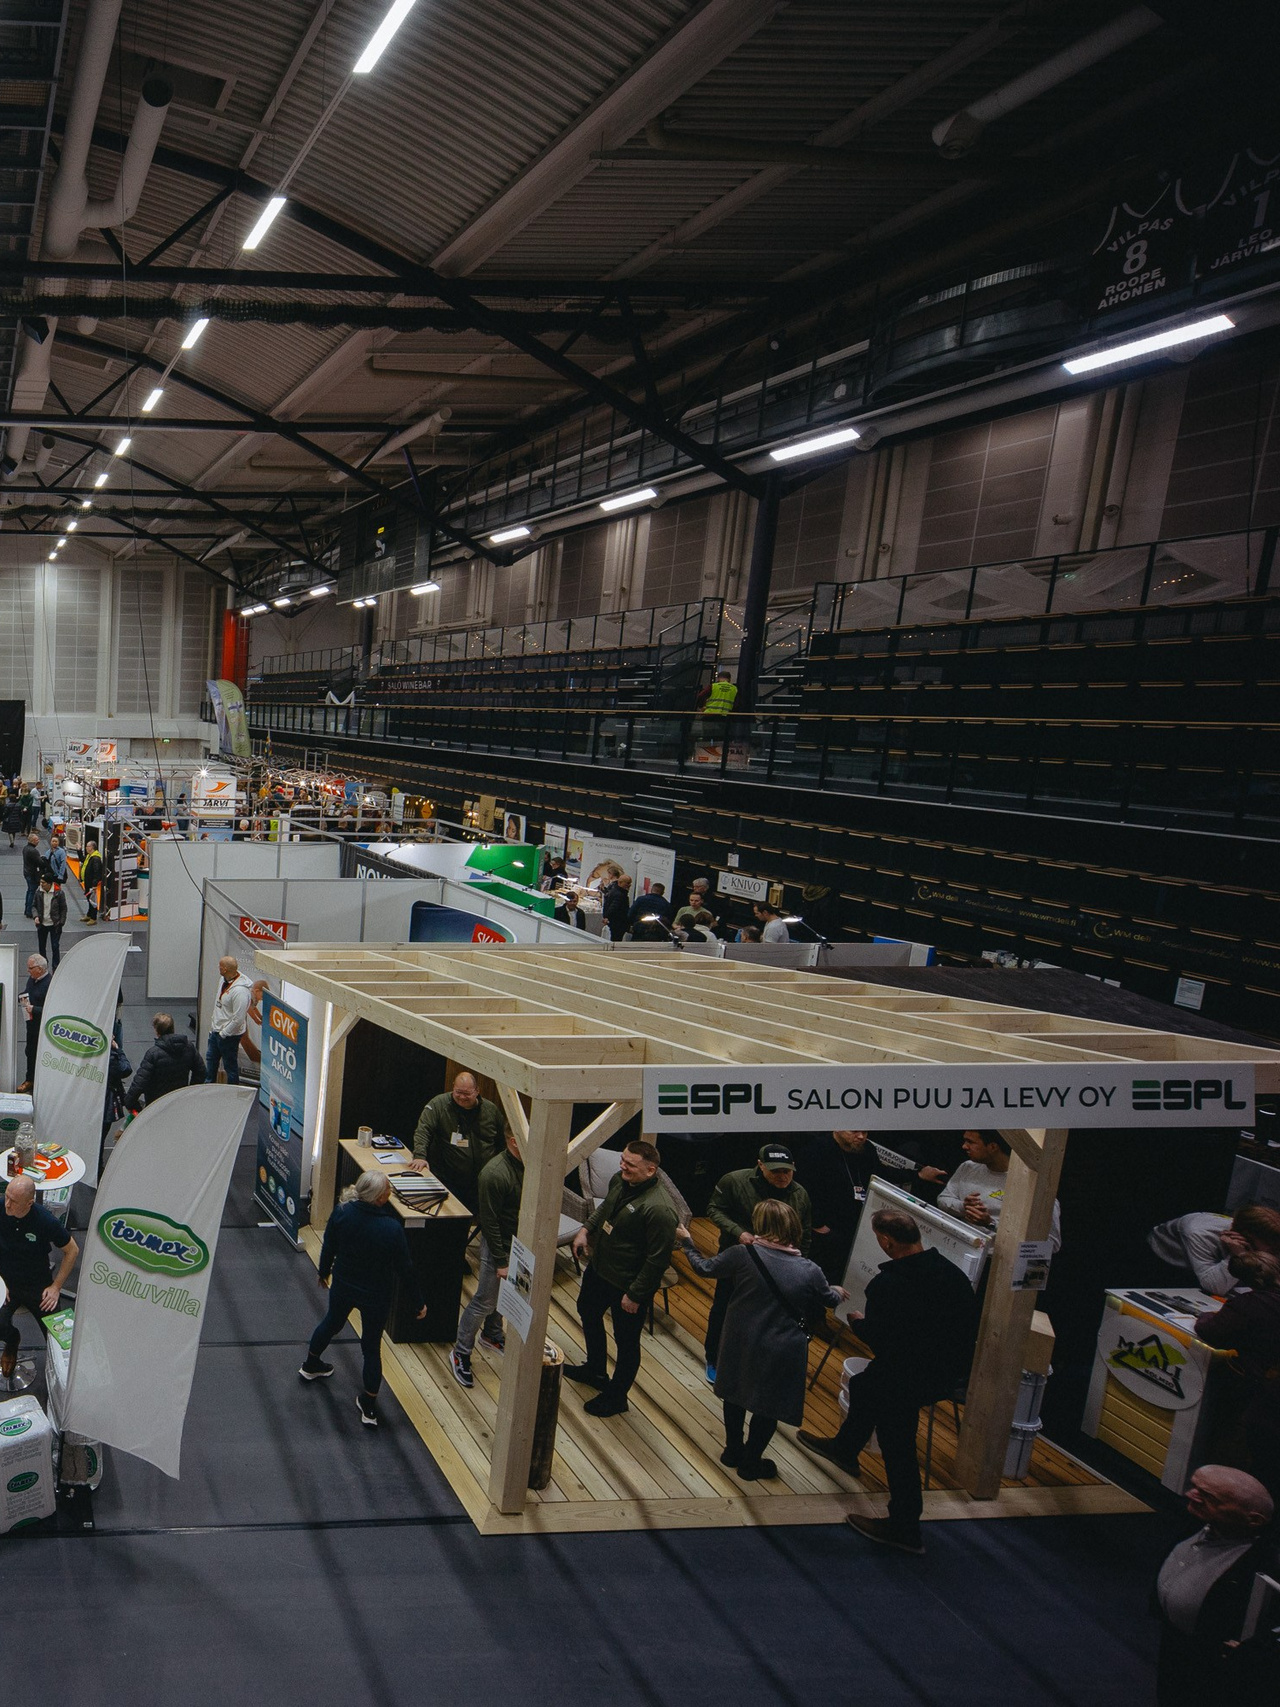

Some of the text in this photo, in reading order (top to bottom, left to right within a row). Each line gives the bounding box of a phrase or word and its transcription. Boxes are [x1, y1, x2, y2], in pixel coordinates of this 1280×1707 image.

[1222, 168, 1280, 206] VILP
[1253, 189, 1271, 228] 1
[1107, 217, 1174, 252] VILPAS
[1238, 229, 1273, 249] LEO
[1123, 239, 1148, 275] 8
[1097, 277, 1167, 310] AHONEN
[1105, 267, 1162, 297] ROOPE
[731, 876, 763, 893] KNIVO
[53, 1023, 99, 1048] termex
[272, 1009, 297, 1041] GVK
[42, 1051, 105, 1084] Selluvilla
[269, 1036, 297, 1071] UTÖ
[272, 1058, 293, 1083] AKVA
[787, 1085, 1117, 1111] SALON PUU JA LEVY OY
[111, 1220, 195, 1264] termex
[90, 1260, 201, 1318] Selluvilla
[1117, 1334, 1183, 1380] MAALI
